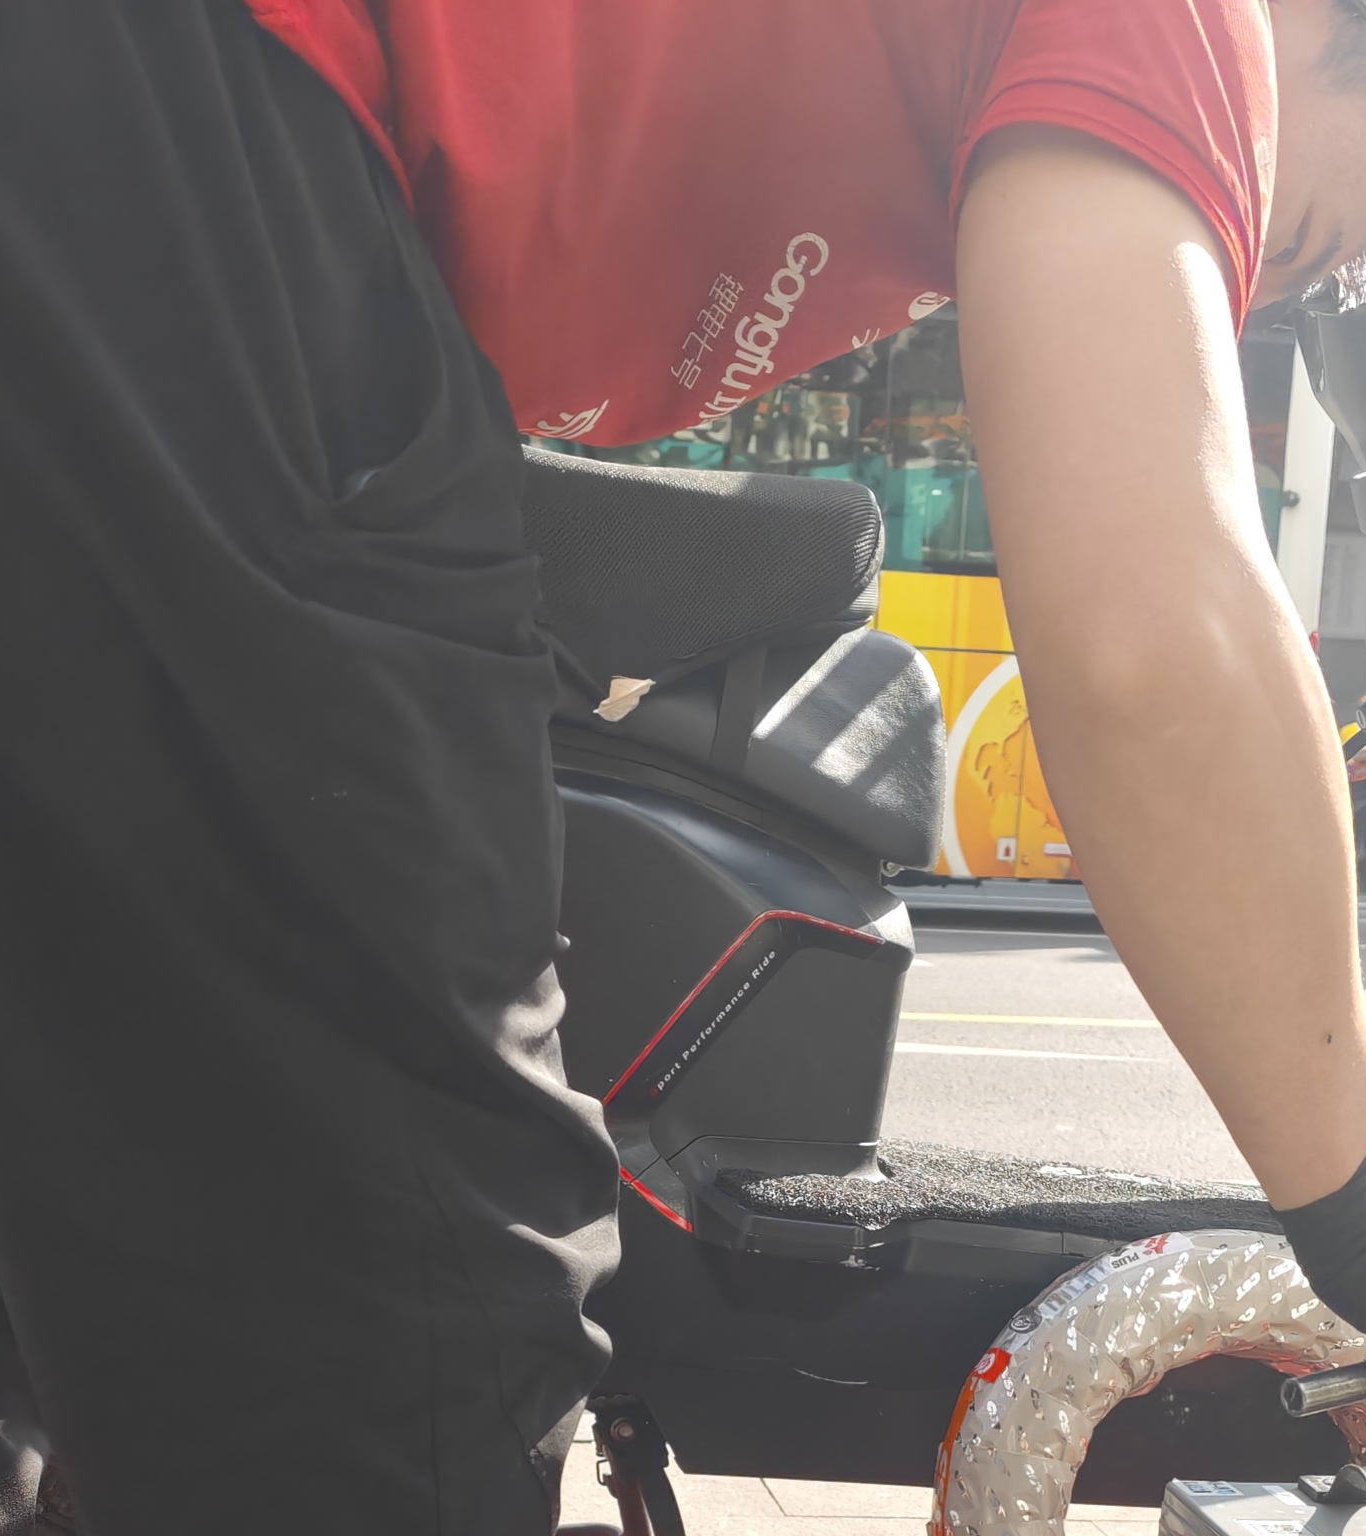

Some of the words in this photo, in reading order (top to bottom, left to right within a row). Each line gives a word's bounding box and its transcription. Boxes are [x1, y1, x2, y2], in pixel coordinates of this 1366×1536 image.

[670, 272, 744, 390] 锂电七号
[720, 231, 830, 391] Gongfu
[650, 1062, 681, 1097] port
[682, 981, 751, 1061] Performance
[751, 950, 776, 980] Ride
